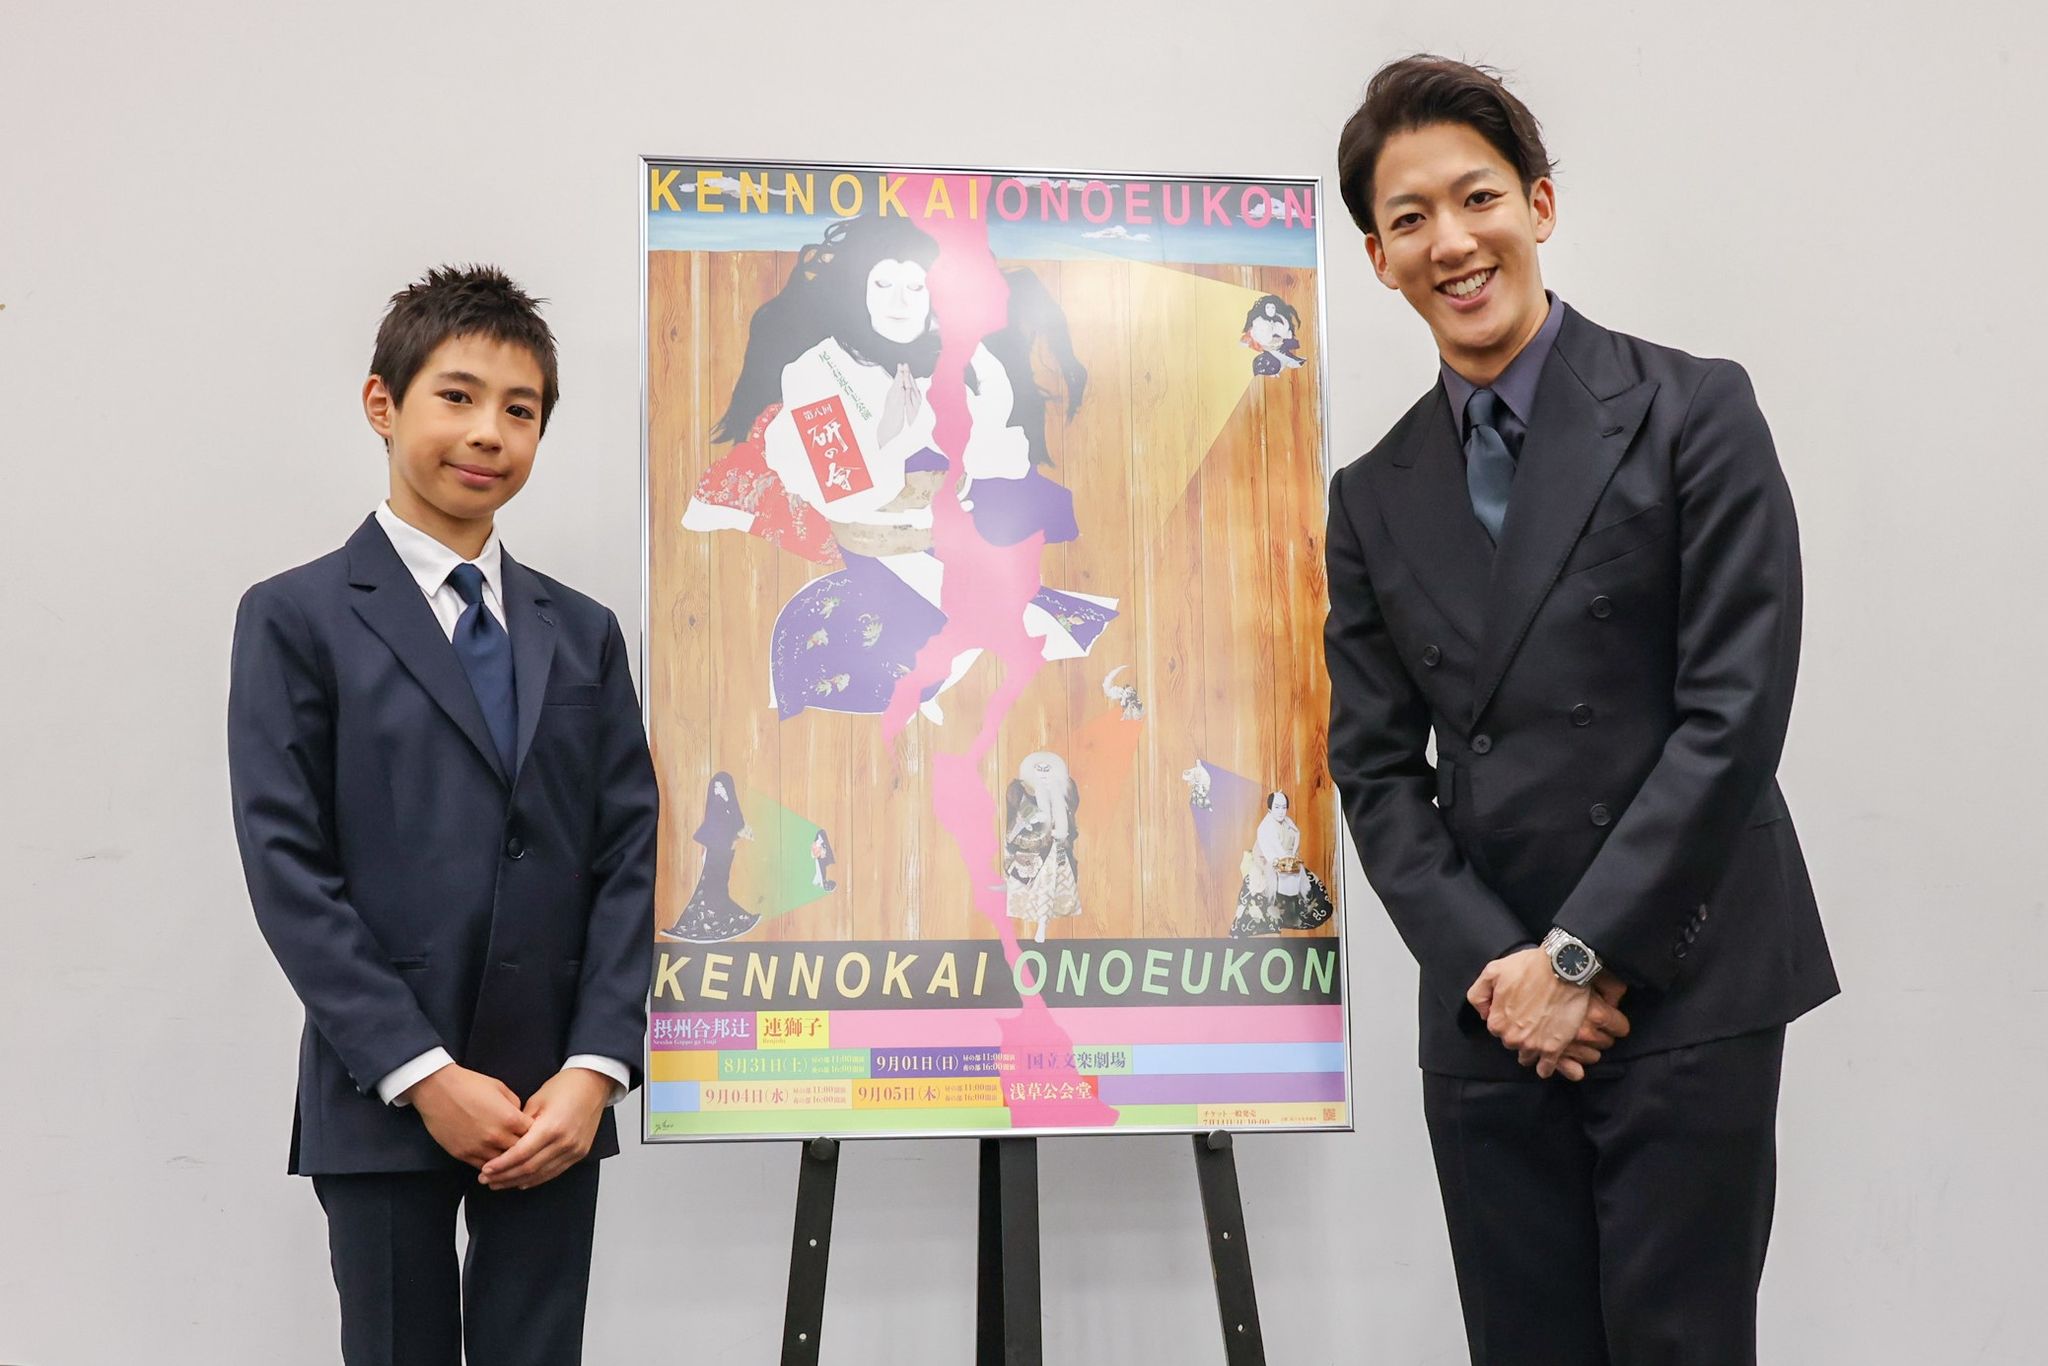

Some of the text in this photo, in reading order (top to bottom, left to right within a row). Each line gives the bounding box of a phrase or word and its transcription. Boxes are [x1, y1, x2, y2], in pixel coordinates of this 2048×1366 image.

[651, 168, 1313, 230] KENNOKAI ONOEUKON
[653, 947, 1335, 1001] KENNOKAI ONOEUKON
[653, 1018, 750, 1039] 摂州合邦辻
[763, 1017, 823, 1037] 連獅子
[1027, 1051, 1126, 1069] 国立文楽劇場
[1010, 1081, 1092, 1101] 浅草公会堂
